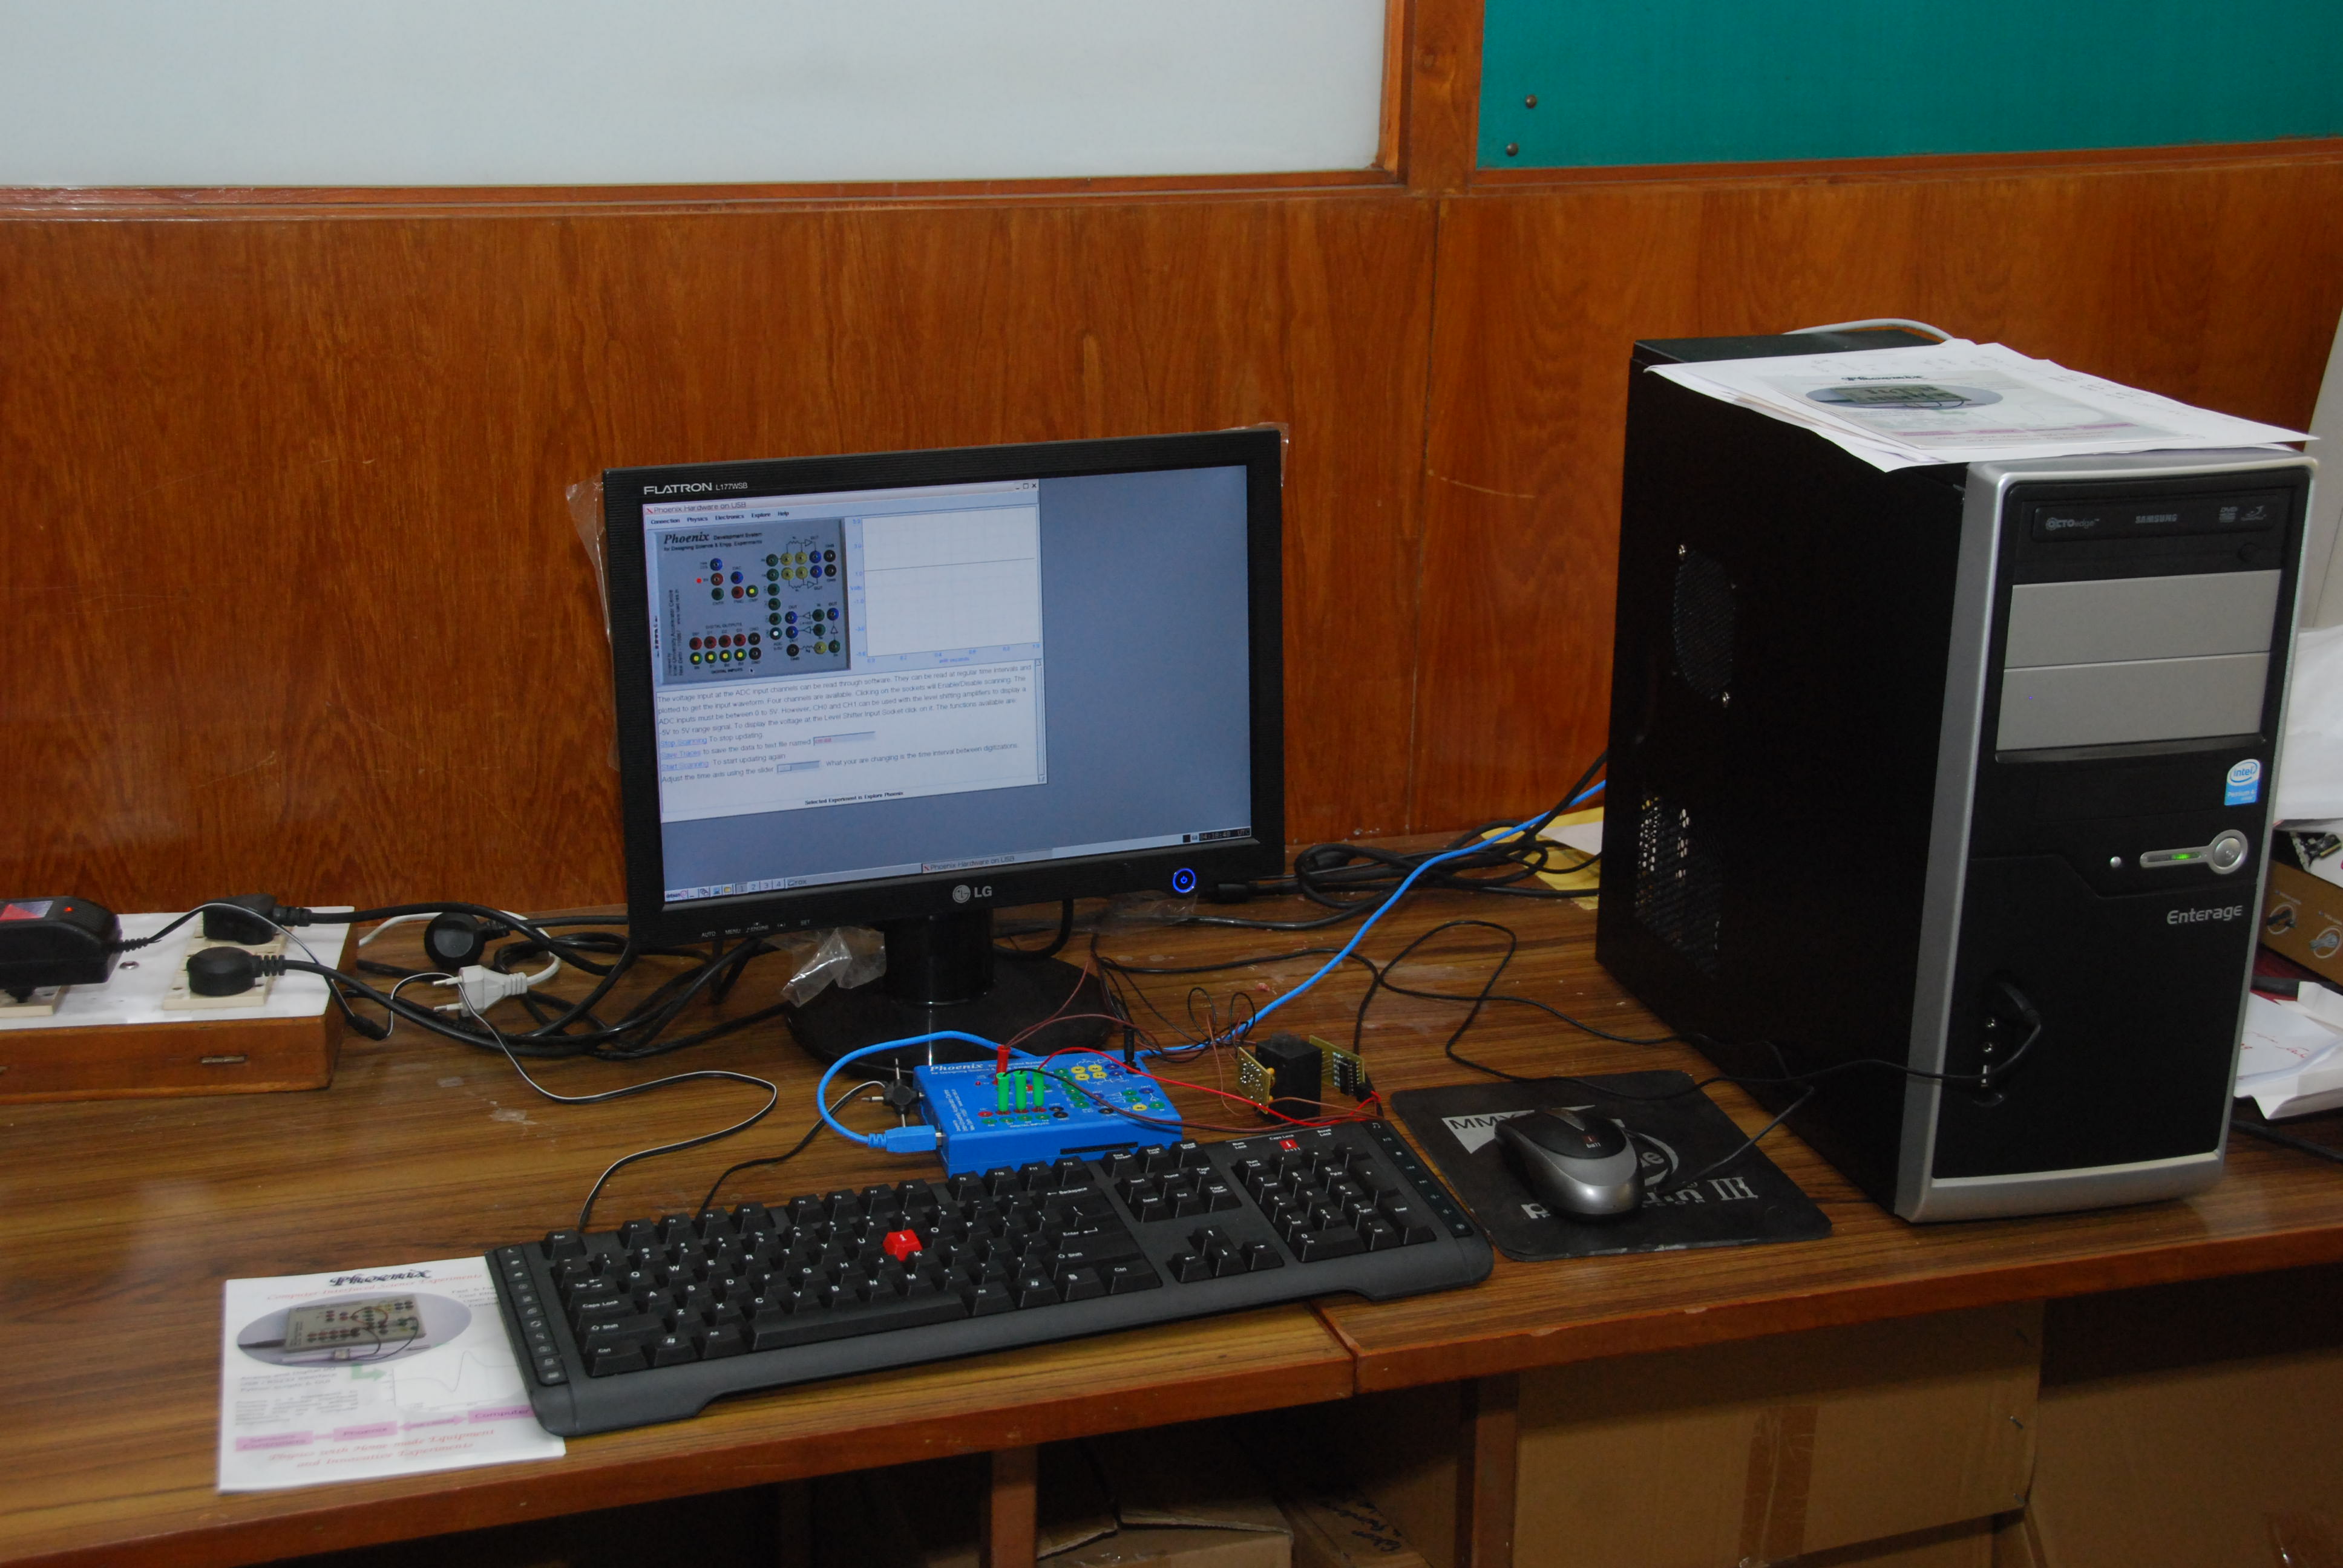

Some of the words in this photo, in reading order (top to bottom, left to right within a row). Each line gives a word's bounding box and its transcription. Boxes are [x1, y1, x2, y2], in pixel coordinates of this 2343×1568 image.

[644, 483, 712, 495] FLATRON
[654, 505, 681, 514] Phoenix
[2135, 514, 2177, 523] SAMSUNG
[664, 531, 709, 544] Phoenix
[672, 694, 695, 703] voltage
[697, 692, 713, 701] input
[753, 687, 768, 696] input
[839, 679, 862, 688] through
[894, 675, 908, 684] They
[957, 669, 977, 678] regular
[658, 706, 680, 716] plotted
[690, 704, 700, 713] get
[715, 702, 731, 711] input
[855, 688, 879, 698] Clicking
[662, 775, 682, 785] Adjust
[727, 769, 744, 778] using
[871, 754, 898, 764] changing
[2233, 766, 2253, 777] intel
[828, 795, 856, 803] Experiment
[930, 862, 955, 871] Phoenix
[958, 858, 988, 867] Hardware
[974, 886, 992, 898] LG
[2166, 906, 2243, 924] Enterage
[930, 1063, 983, 1072] Phoenix
[329, 1270, 432, 1287] Phoenix
[474, 1409, 529, 1419] Computer
